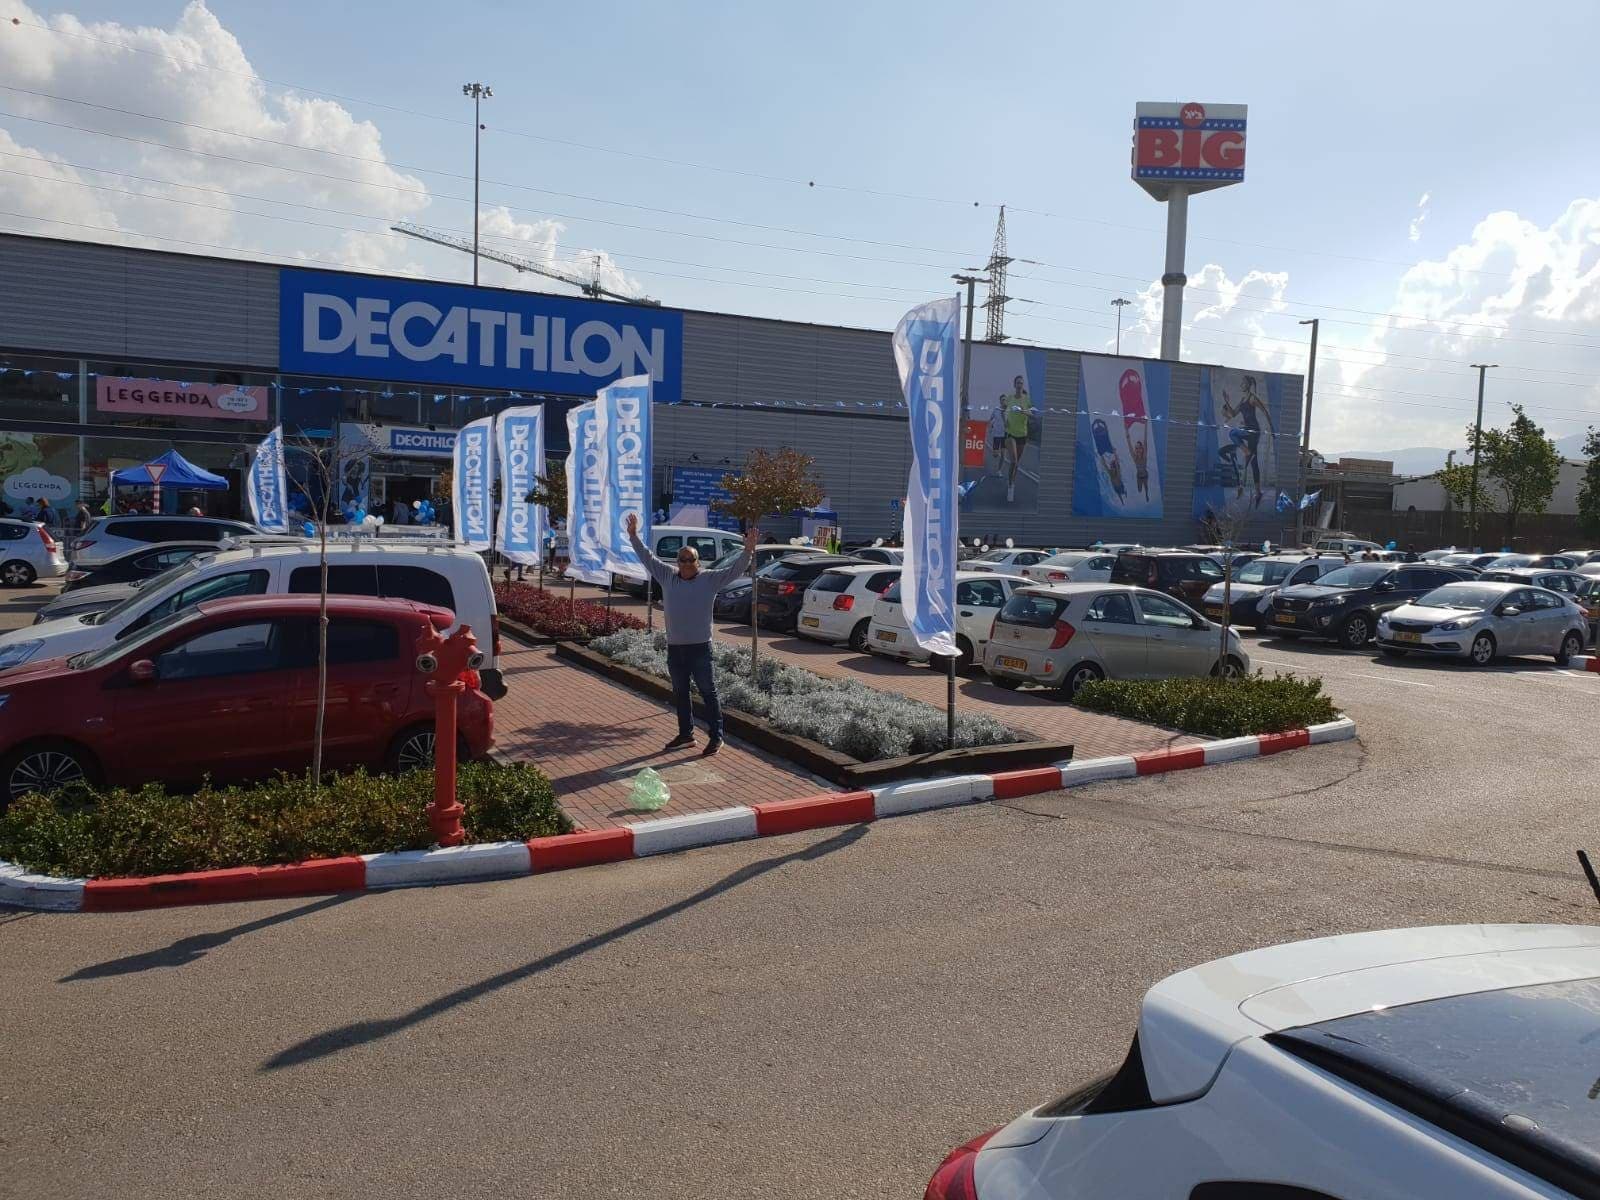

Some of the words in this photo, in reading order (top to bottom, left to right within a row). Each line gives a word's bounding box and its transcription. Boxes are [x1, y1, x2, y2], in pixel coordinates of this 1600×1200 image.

[303, 292, 665, 382] DECATHLON
[106, 386, 213, 409] LEGGENDA
[395, 434, 456, 448] DECATHLO
[12, 481, 62, 491] LEGGENDA
